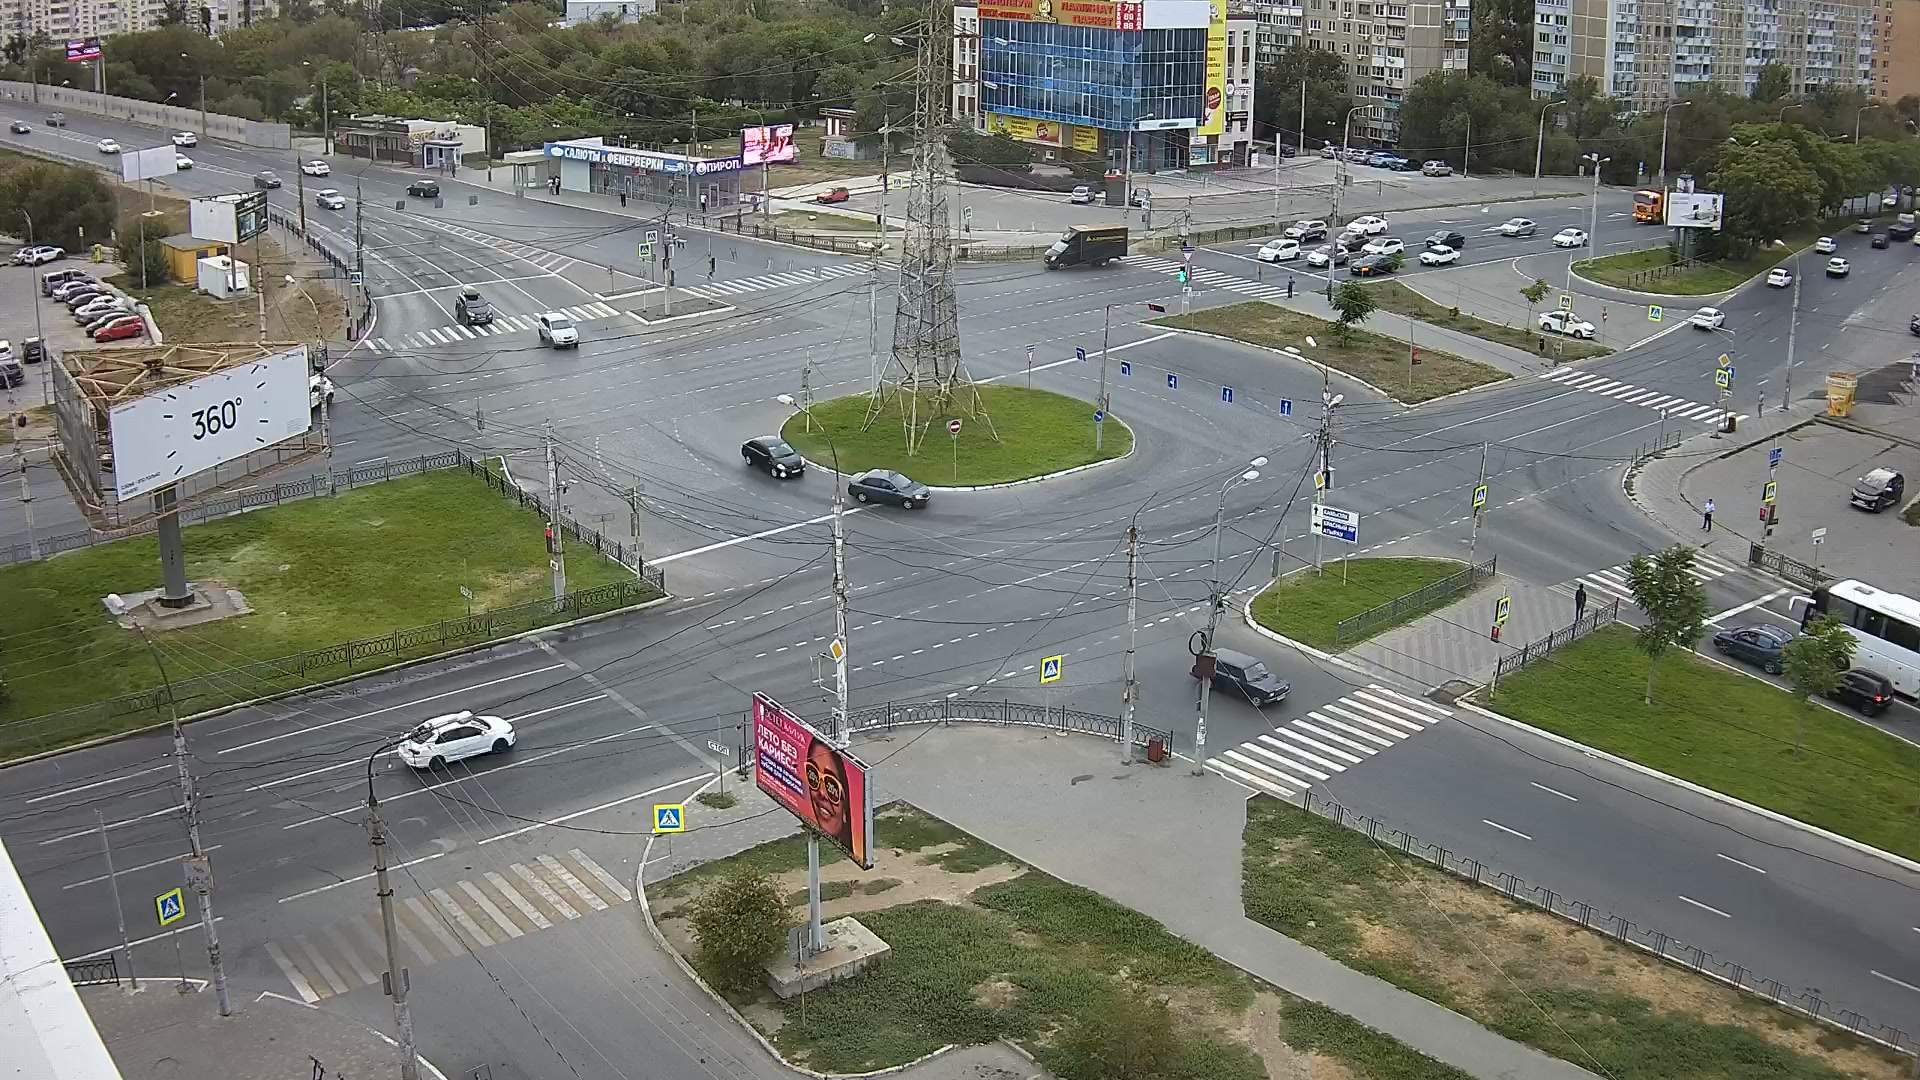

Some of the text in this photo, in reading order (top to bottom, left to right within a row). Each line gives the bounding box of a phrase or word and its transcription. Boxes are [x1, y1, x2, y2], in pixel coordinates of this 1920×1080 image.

[1061, 2, 1114, 14] ЛАМИНАТ
[1072, 15, 1114, 26] ПАРКЕТ
[564, 147, 600, 162] САЛЮТЫ
[707, 159, 742, 172] ПИРОП
[191, 397, 242, 441] 360°
[758, 724, 798, 760] ЛЕТО БЕЗ
[758, 736, 798, 773] КАРИЕСА
